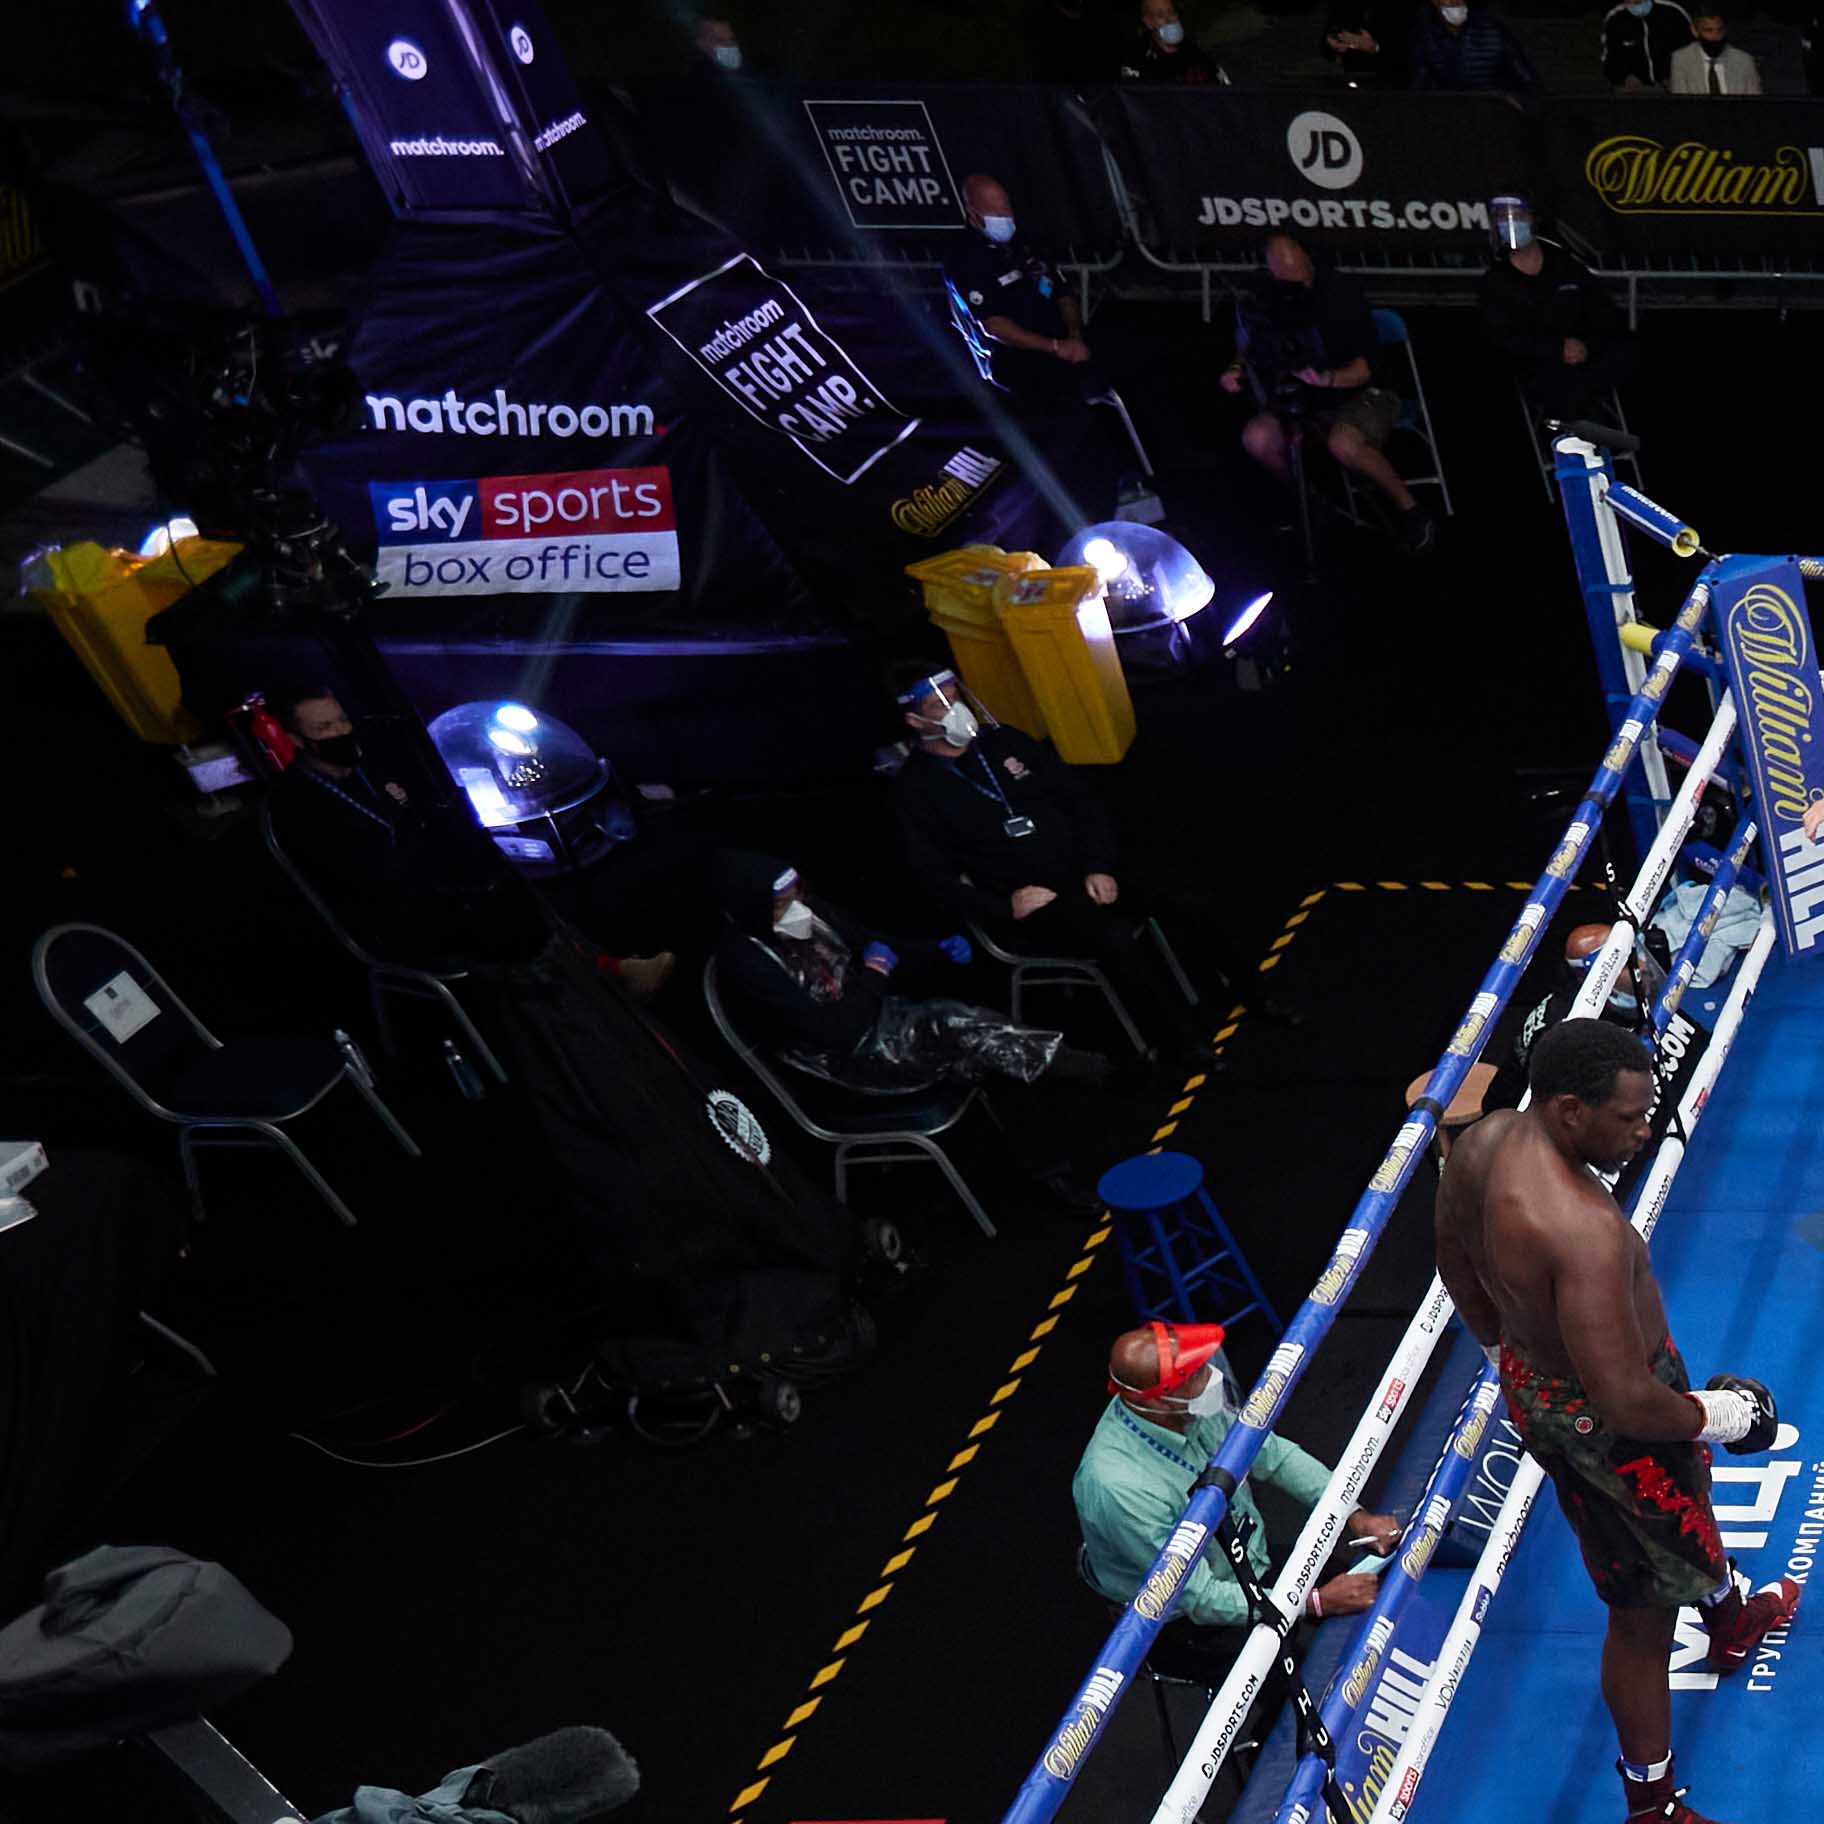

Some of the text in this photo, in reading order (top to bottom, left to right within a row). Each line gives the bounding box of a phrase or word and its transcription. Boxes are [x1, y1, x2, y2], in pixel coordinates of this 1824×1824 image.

[391, 136, 505, 157] matchroom.
[827, 123, 925, 143] matchroom.
[1302, 129, 1351, 169] JD
[836, 145, 932, 173] FIGHT
[1585, 135, 1807, 212] William
[848, 176, 951, 207] CAMP.
[1198, 195, 1491, 231] JDSPORTS.COM
[725, 324, 829, 413] FIGHT
[386, 477, 662, 537] sky sports
[404, 547, 651, 586] box office
[1340, 1436, 1381, 1505] matchroom.
[1167, 1520, 1208, 1562] HILL
[1297, 1512, 1340, 1595] JDSPORTS.COM
[1364, 1647, 1440, 1741] HILL
